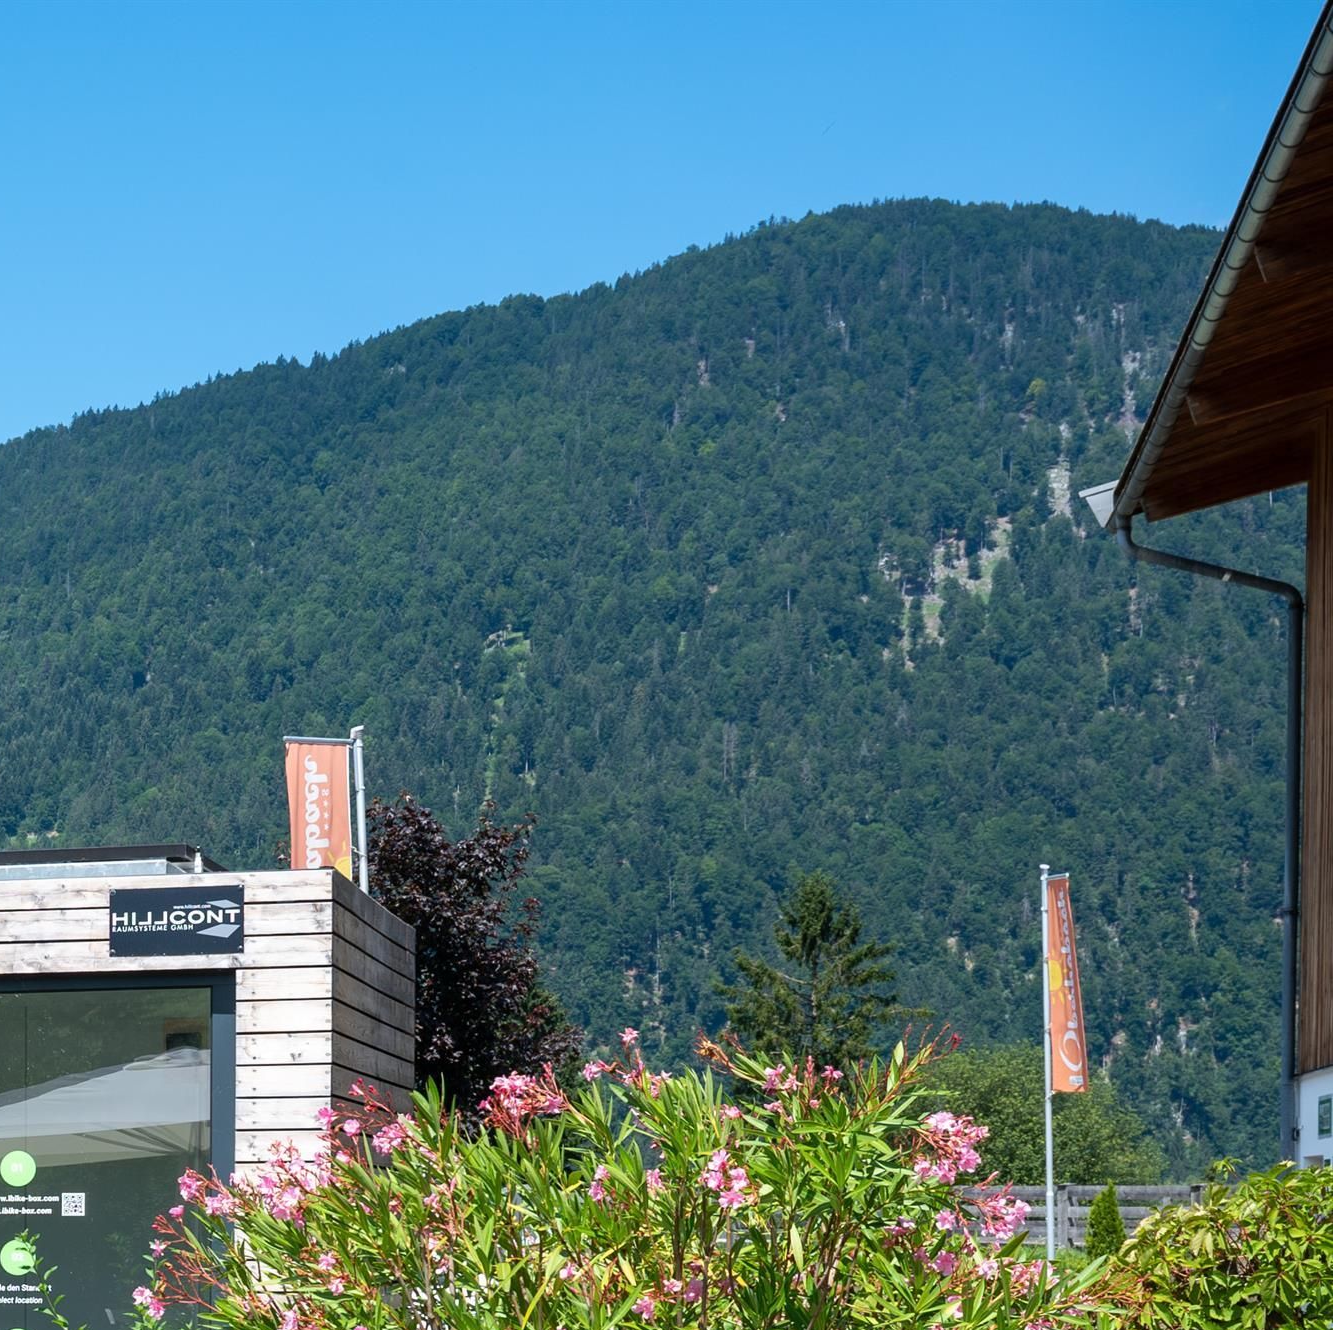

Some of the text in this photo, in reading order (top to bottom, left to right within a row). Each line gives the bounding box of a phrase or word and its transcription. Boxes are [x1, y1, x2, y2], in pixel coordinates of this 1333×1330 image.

[112, 924, 168, 933] RAUMSYSTEME
[7, 1284, 20, 1292] den
[16, 1296, 43, 1304] location
